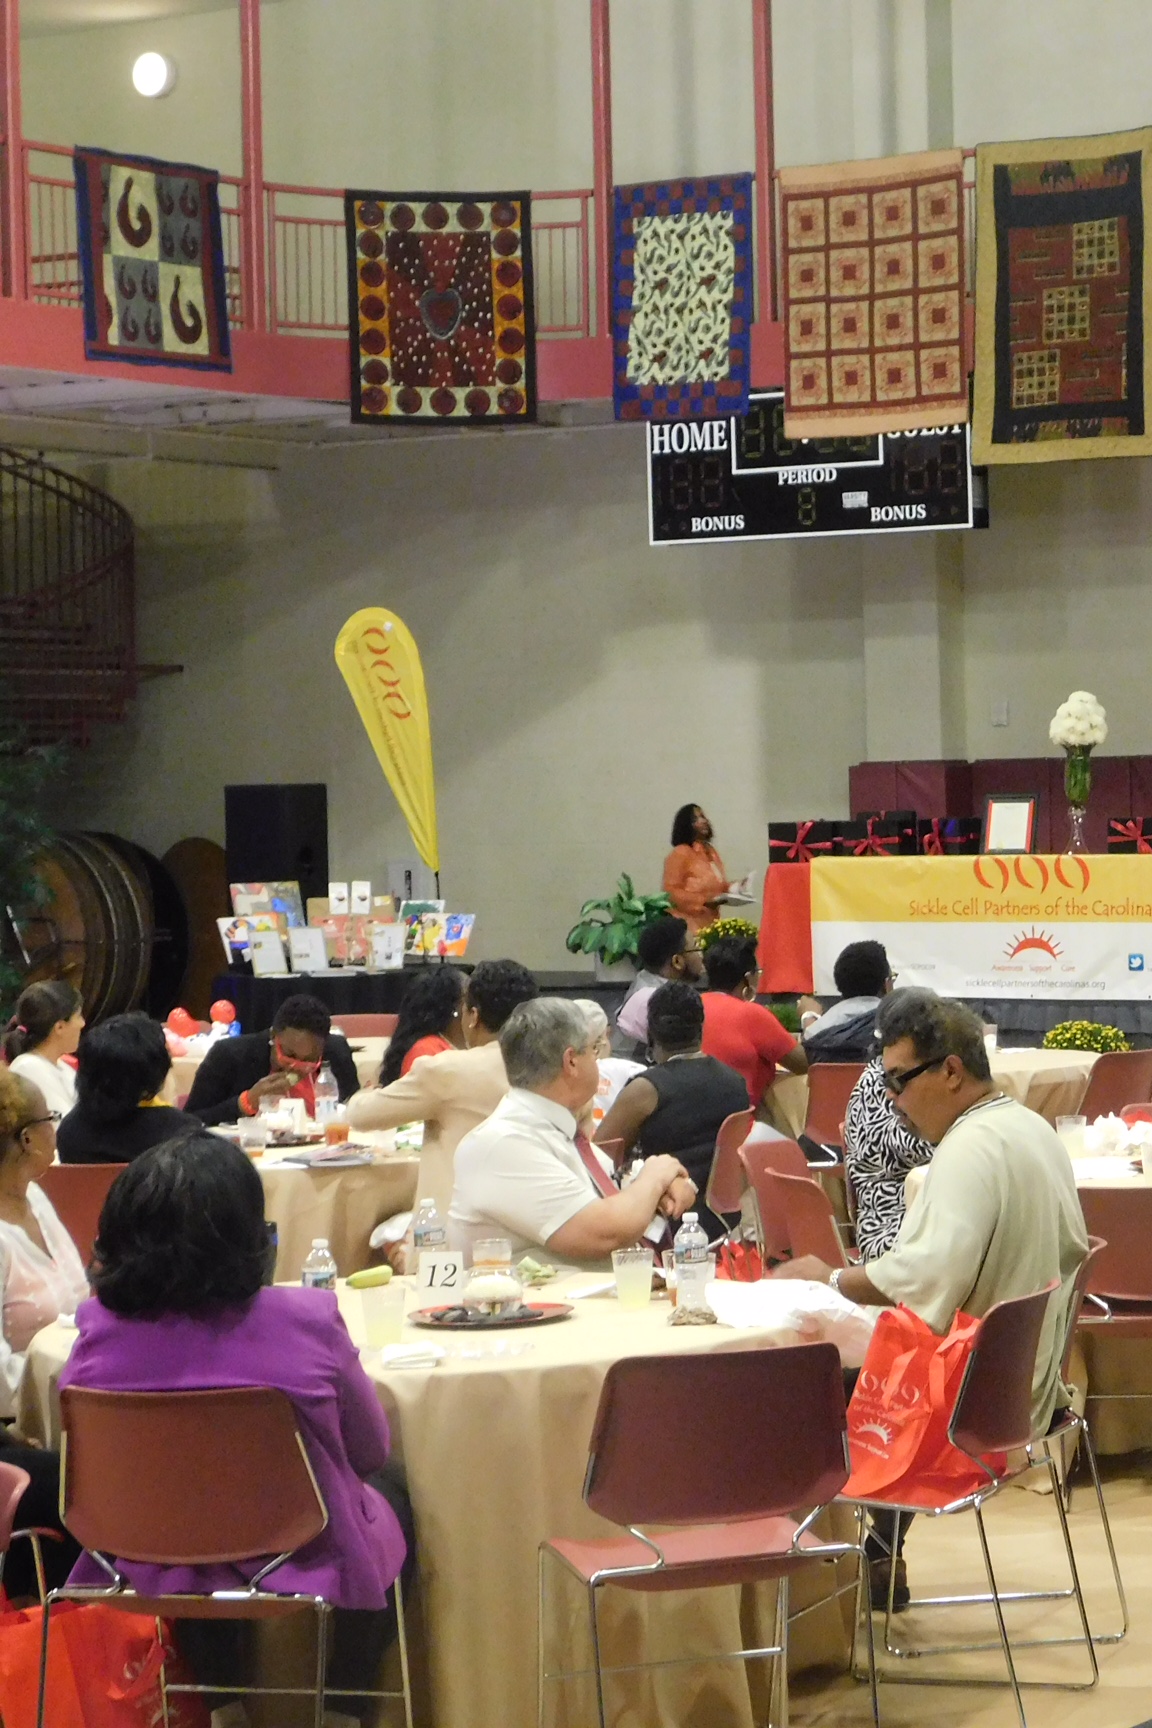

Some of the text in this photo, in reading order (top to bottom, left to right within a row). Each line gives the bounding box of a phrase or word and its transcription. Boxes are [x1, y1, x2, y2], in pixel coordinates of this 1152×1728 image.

[652, 421, 728, 454] HOME
[777, 467, 838, 485] PERIOD
[871, 504, 927, 522] BONUS
[691, 515, 745, 533] BONUS
[909, 898, 947, 916] Sickle
[952, 898, 979, 916] Cell
[984, 899, 1040, 917] Partners
[1044, 896, 1063, 916] of
[1065, 898, 1088, 916] the
[424, 1262, 458, 1288] 12
